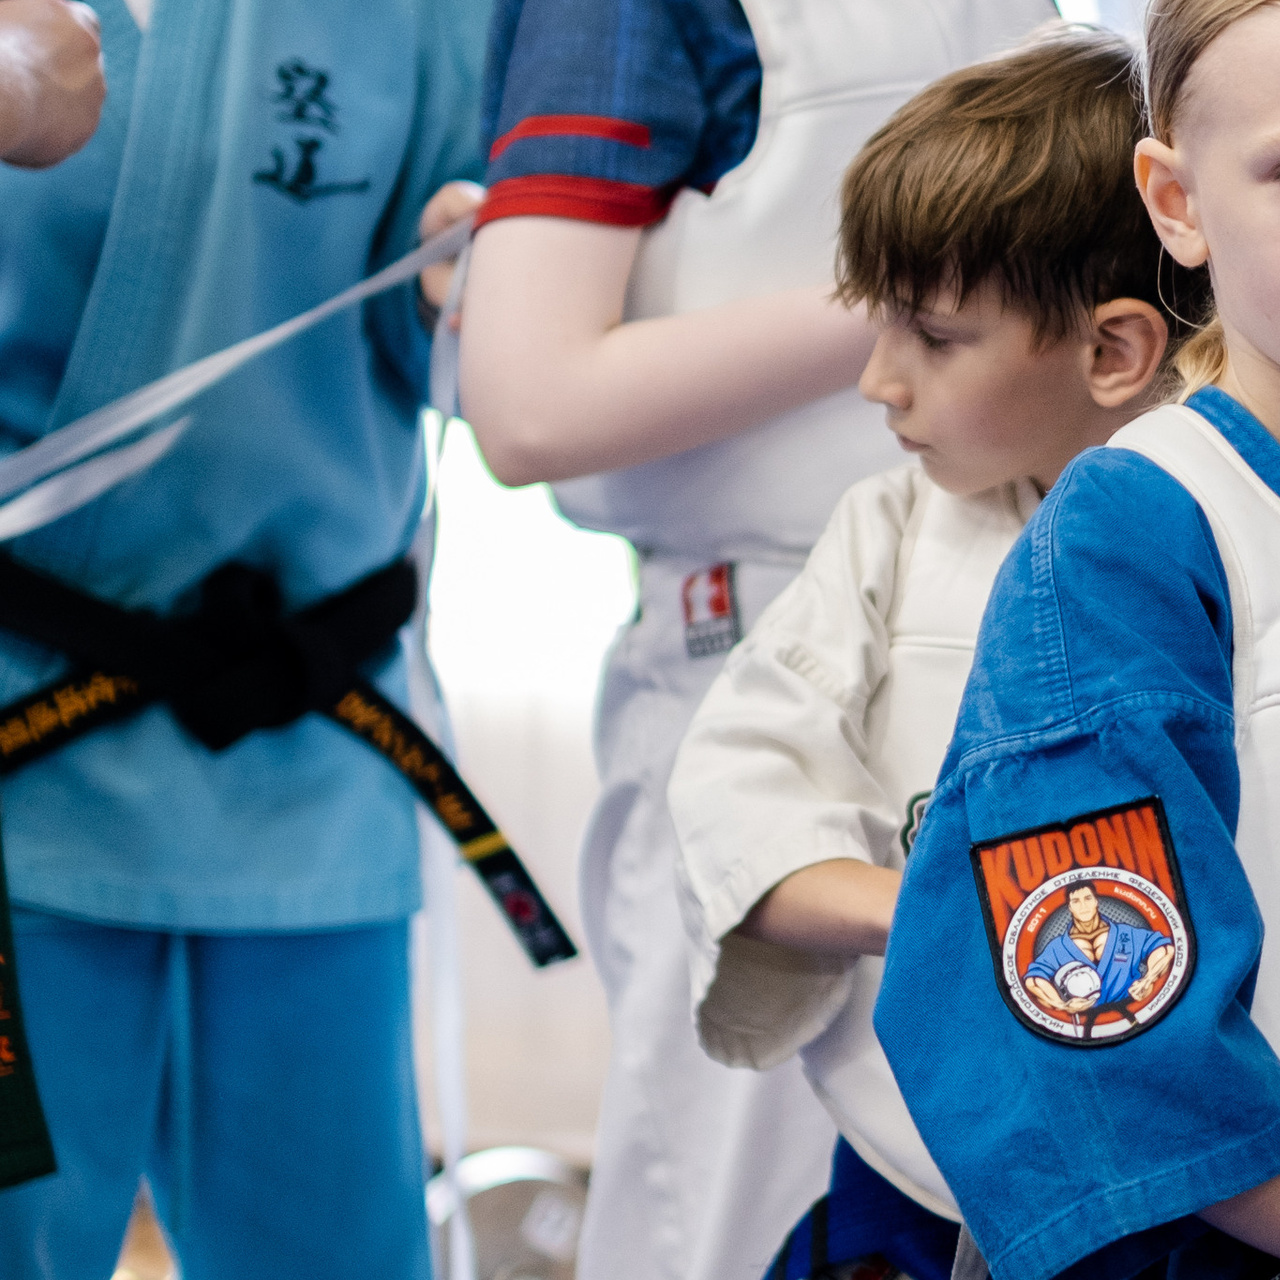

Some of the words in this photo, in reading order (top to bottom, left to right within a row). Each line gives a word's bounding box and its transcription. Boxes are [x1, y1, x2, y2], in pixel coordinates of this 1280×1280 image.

[979, 805, 1177, 947] KUDONN
[1053, 870, 1121, 888] ОТДЕЛЕНИЕ
[1009, 889, 1048, 946] ОБЛАСТНОЕ
[1027, 907, 1047, 933] 2011
[1128, 877, 1180, 930] ФЕДЕРАЦИИ
[1175, 937, 1184, 968] КУДО
[1007, 953, 1064, 1031] НИЖЕГОРОДСКОЕ
[1148, 974, 1178, 1011] РОССИИ
